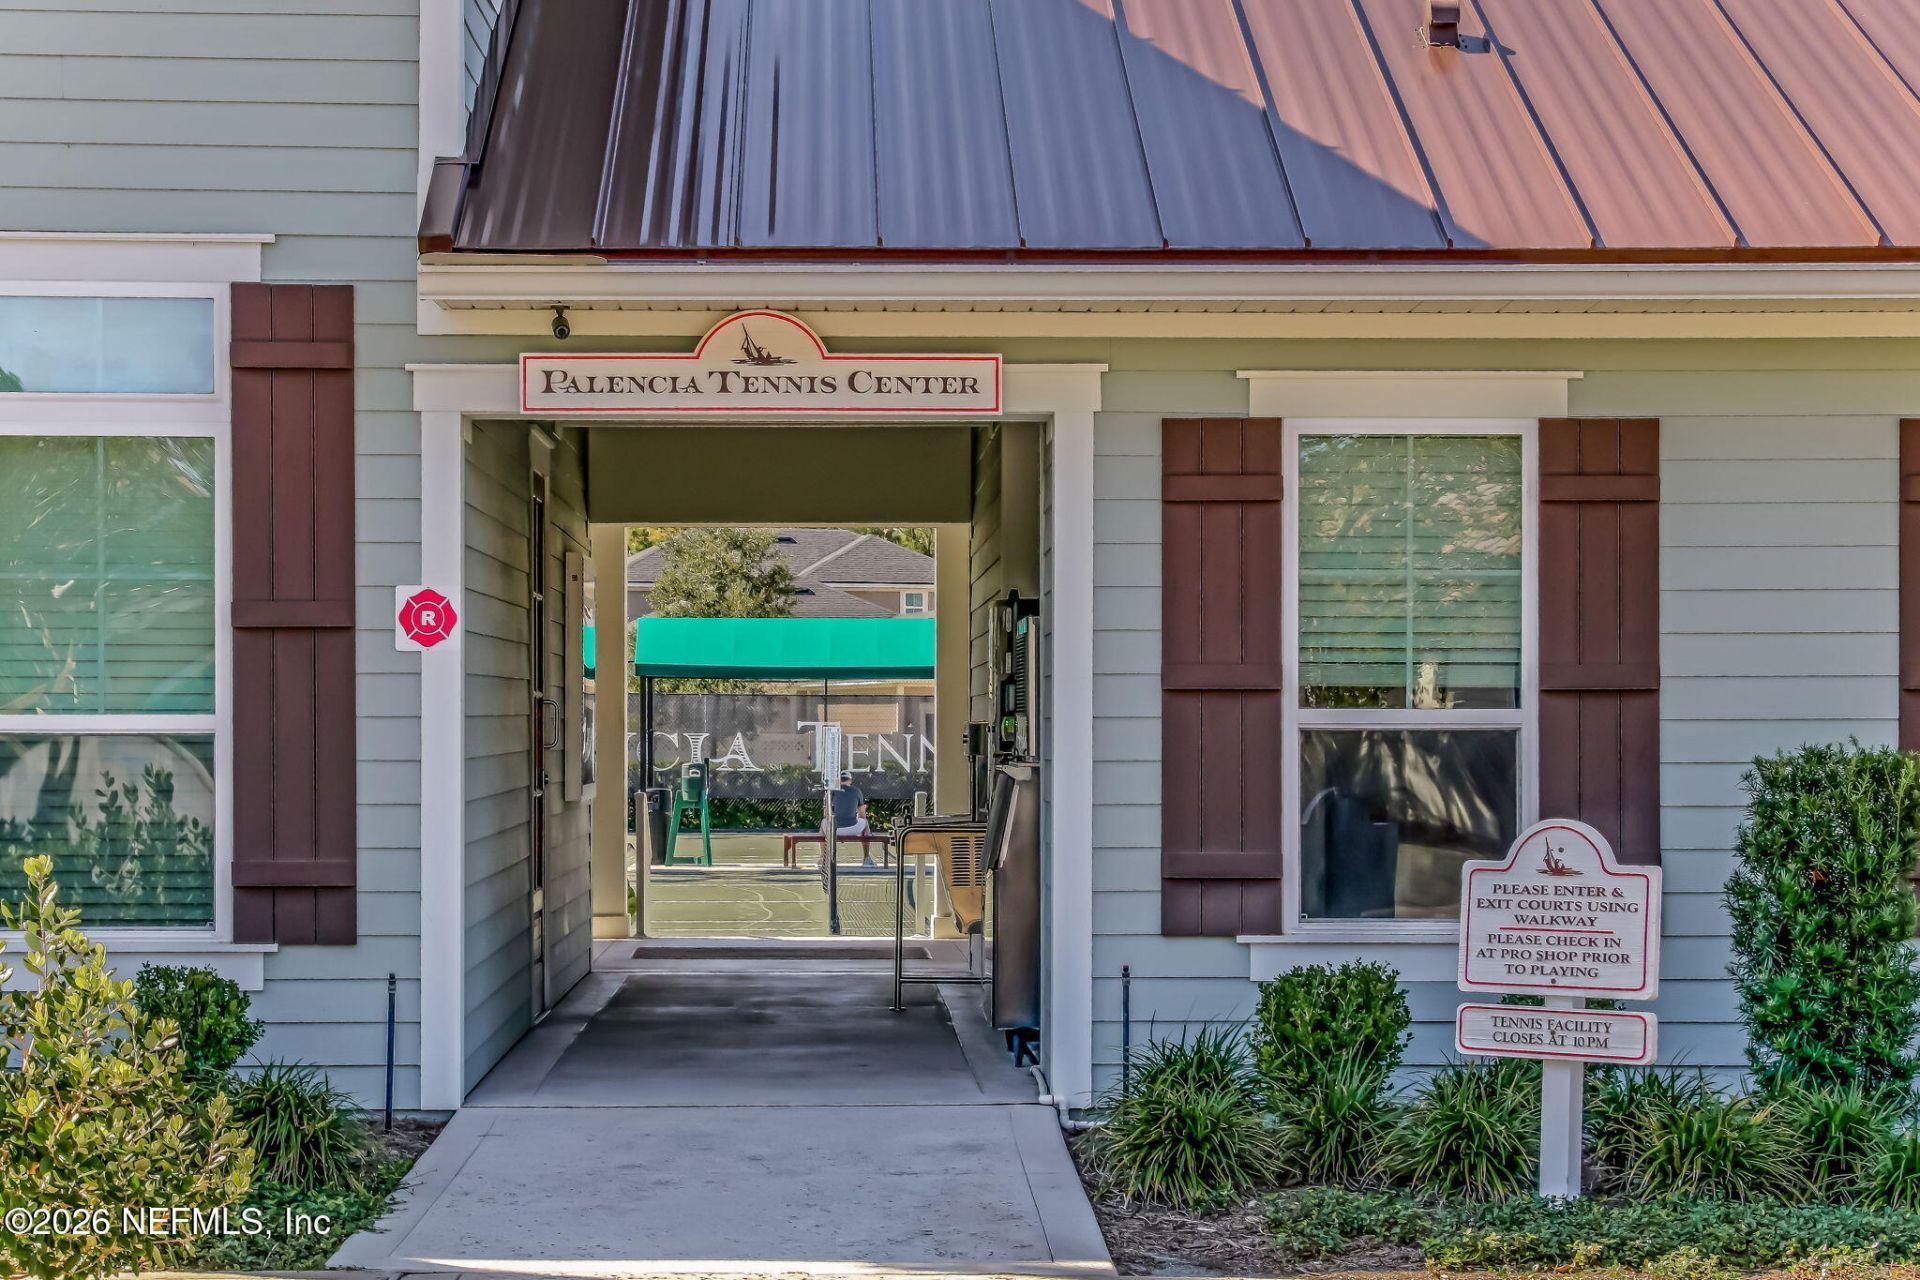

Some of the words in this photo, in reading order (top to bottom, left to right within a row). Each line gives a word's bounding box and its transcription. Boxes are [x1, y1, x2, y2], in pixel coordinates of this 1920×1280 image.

[541, 369, 703, 394] PALENCIA
[708, 369, 837, 394] TENNIS
[847, 369, 980, 395] CENTER
[421, 610, 436, 626] R
[627, 732, 764, 771] CIA
[1492, 884, 1549, 896] PLEASE
[1553, 885, 1606, 898] ENTER
[1611, 887, 1624, 898] &
[1476, 898, 1513, 910] EXIT
[1517, 899, 1583, 912] COURTS
[1587, 902, 1639, 913] USING
[1514, 914, 1598, 927] WALKWAY
[1487, 934, 1542, 945] PLEASE
[1546, 935, 1599, 947] CHECK
[1604, 937, 1622, 948] IN
[1476, 948, 1496, 959] AT
[1501, 949, 1532, 961] PRO
[1536, 950, 1578, 962] SHOP
[1582, 952, 1631, 964] PRIOR
[1504, 963, 1525, 975] TO
[1530, 964, 1599, 978] PLAYING
[1491, 1016, 1542, 1030] TENNIS
[1547, 1019, 1613, 1033] FACILITY
[1492, 1032, 1544, 1045] CLOSES
[1549, 1034, 1568, 1046] AT
